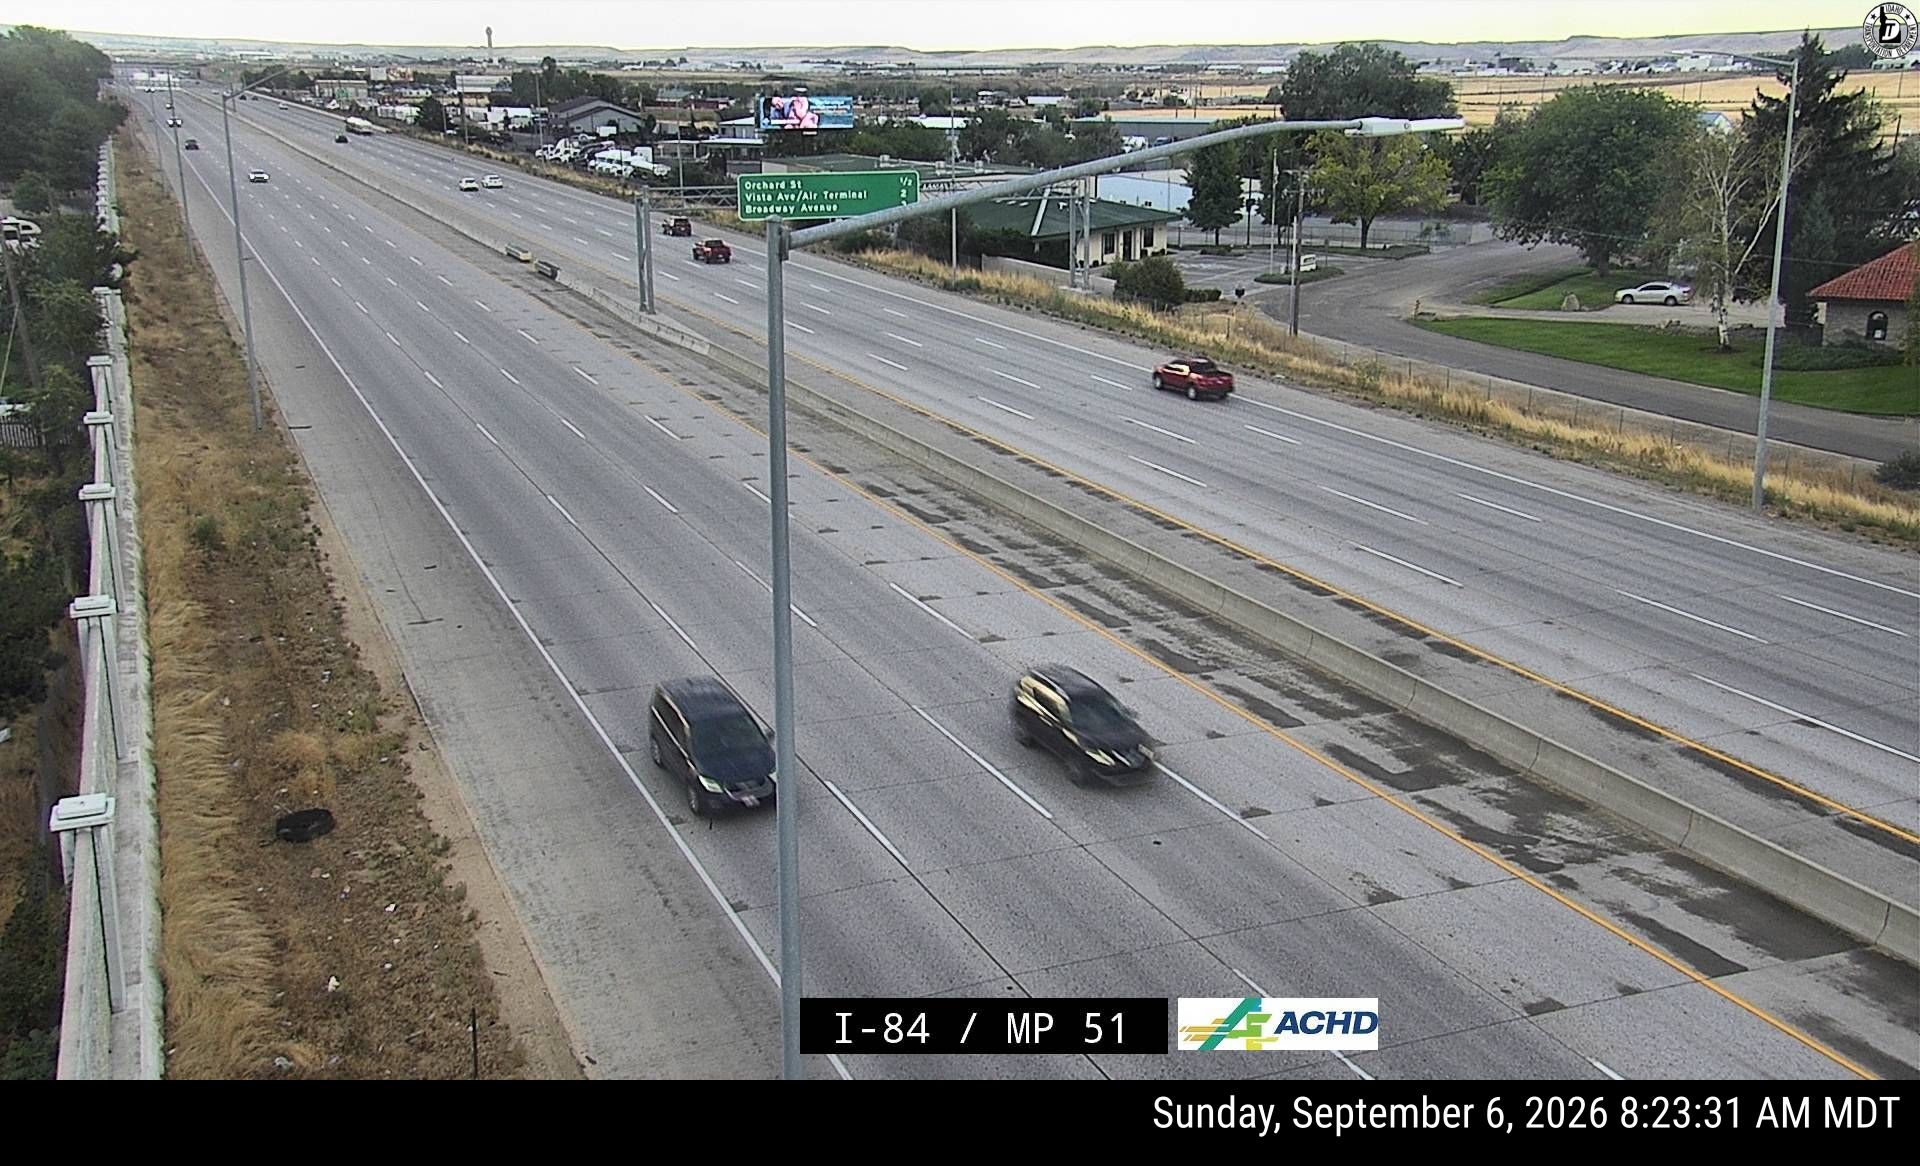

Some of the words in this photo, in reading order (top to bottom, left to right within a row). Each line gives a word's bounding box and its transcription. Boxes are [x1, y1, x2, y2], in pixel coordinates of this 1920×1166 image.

[744, 180, 786, 190] Orchard
[790, 180, 802, 189] St
[745, 192, 773, 202] Vista
[777, 191, 818, 202] Ave/Air
[823, 190, 868, 200] Terminal
[900, 189, 907, 198] 2
[745, 204, 795, 214] Broadway
[800, 203, 838, 213] Avenue
